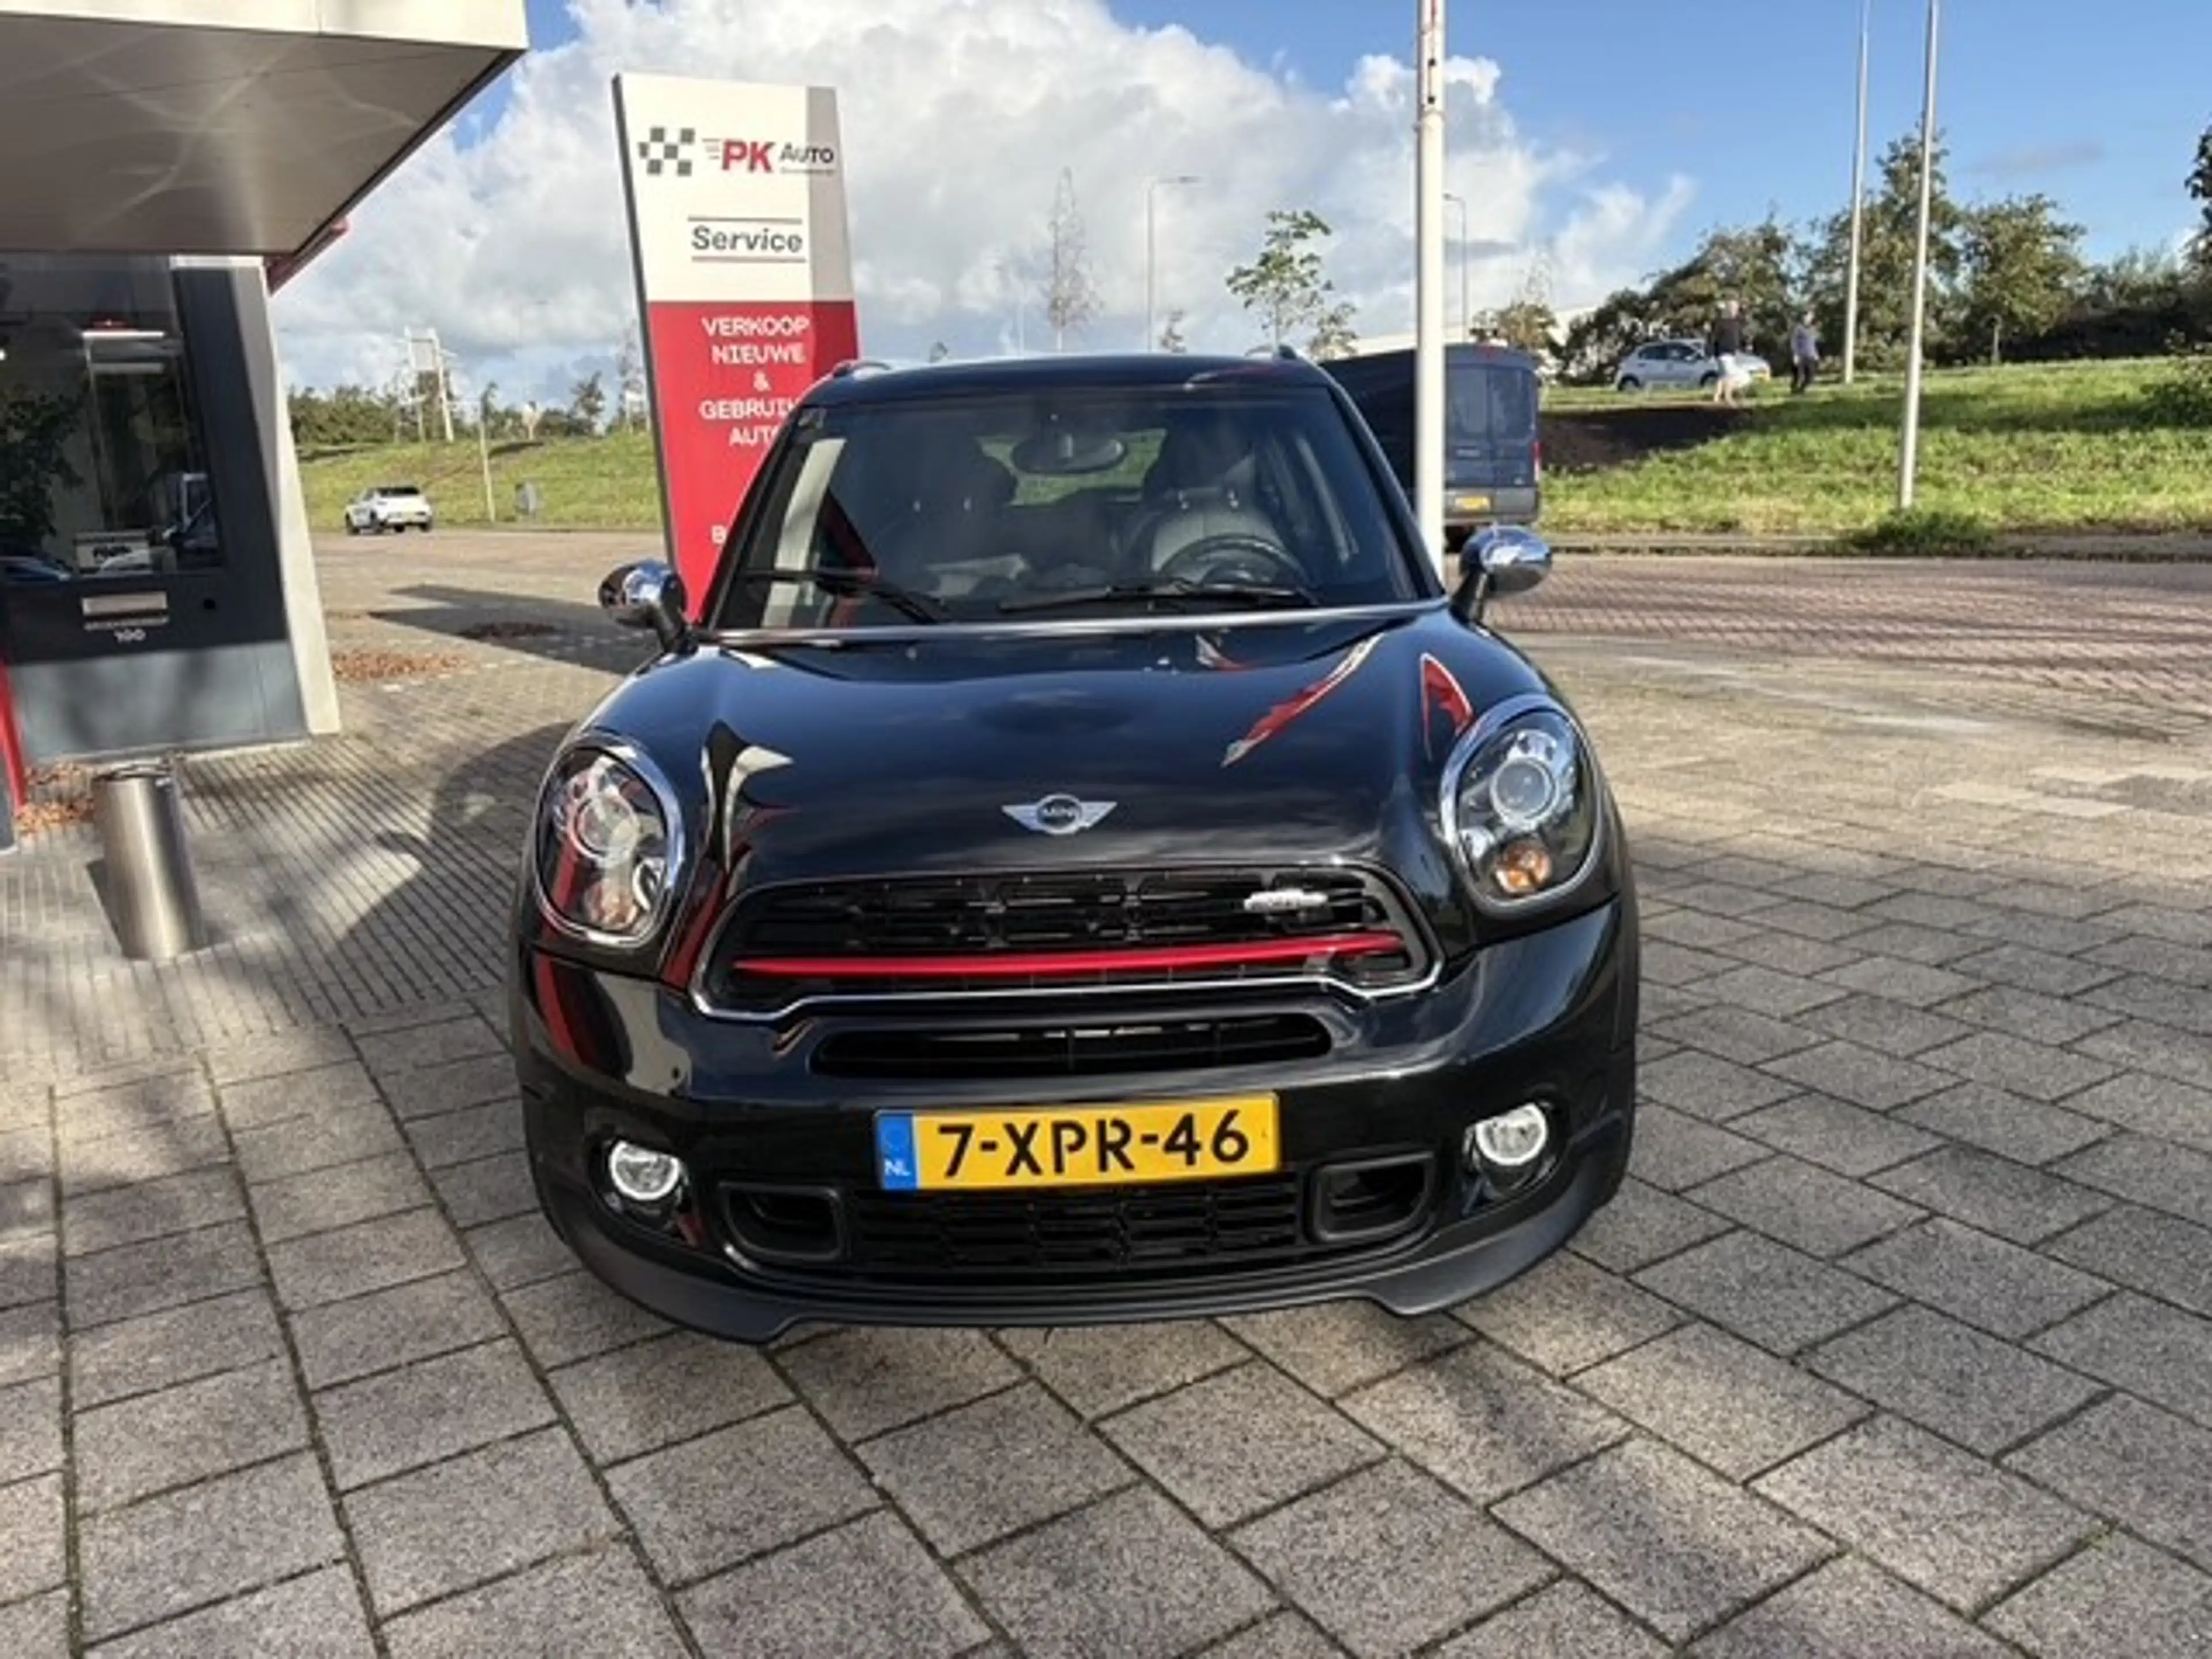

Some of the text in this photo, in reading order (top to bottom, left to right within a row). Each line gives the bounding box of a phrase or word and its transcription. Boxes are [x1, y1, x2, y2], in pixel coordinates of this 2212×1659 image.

[721, 140, 775, 172] PK
[691, 225, 802, 252] Service
[702, 316, 810, 337] VERKOOP
[711, 344, 805, 364] NIEUWE
[753, 372, 771, 392] &
[938, 1110, 1249, 1177] 7-XPR-46
[885, 1160, 910, 1178] NL
